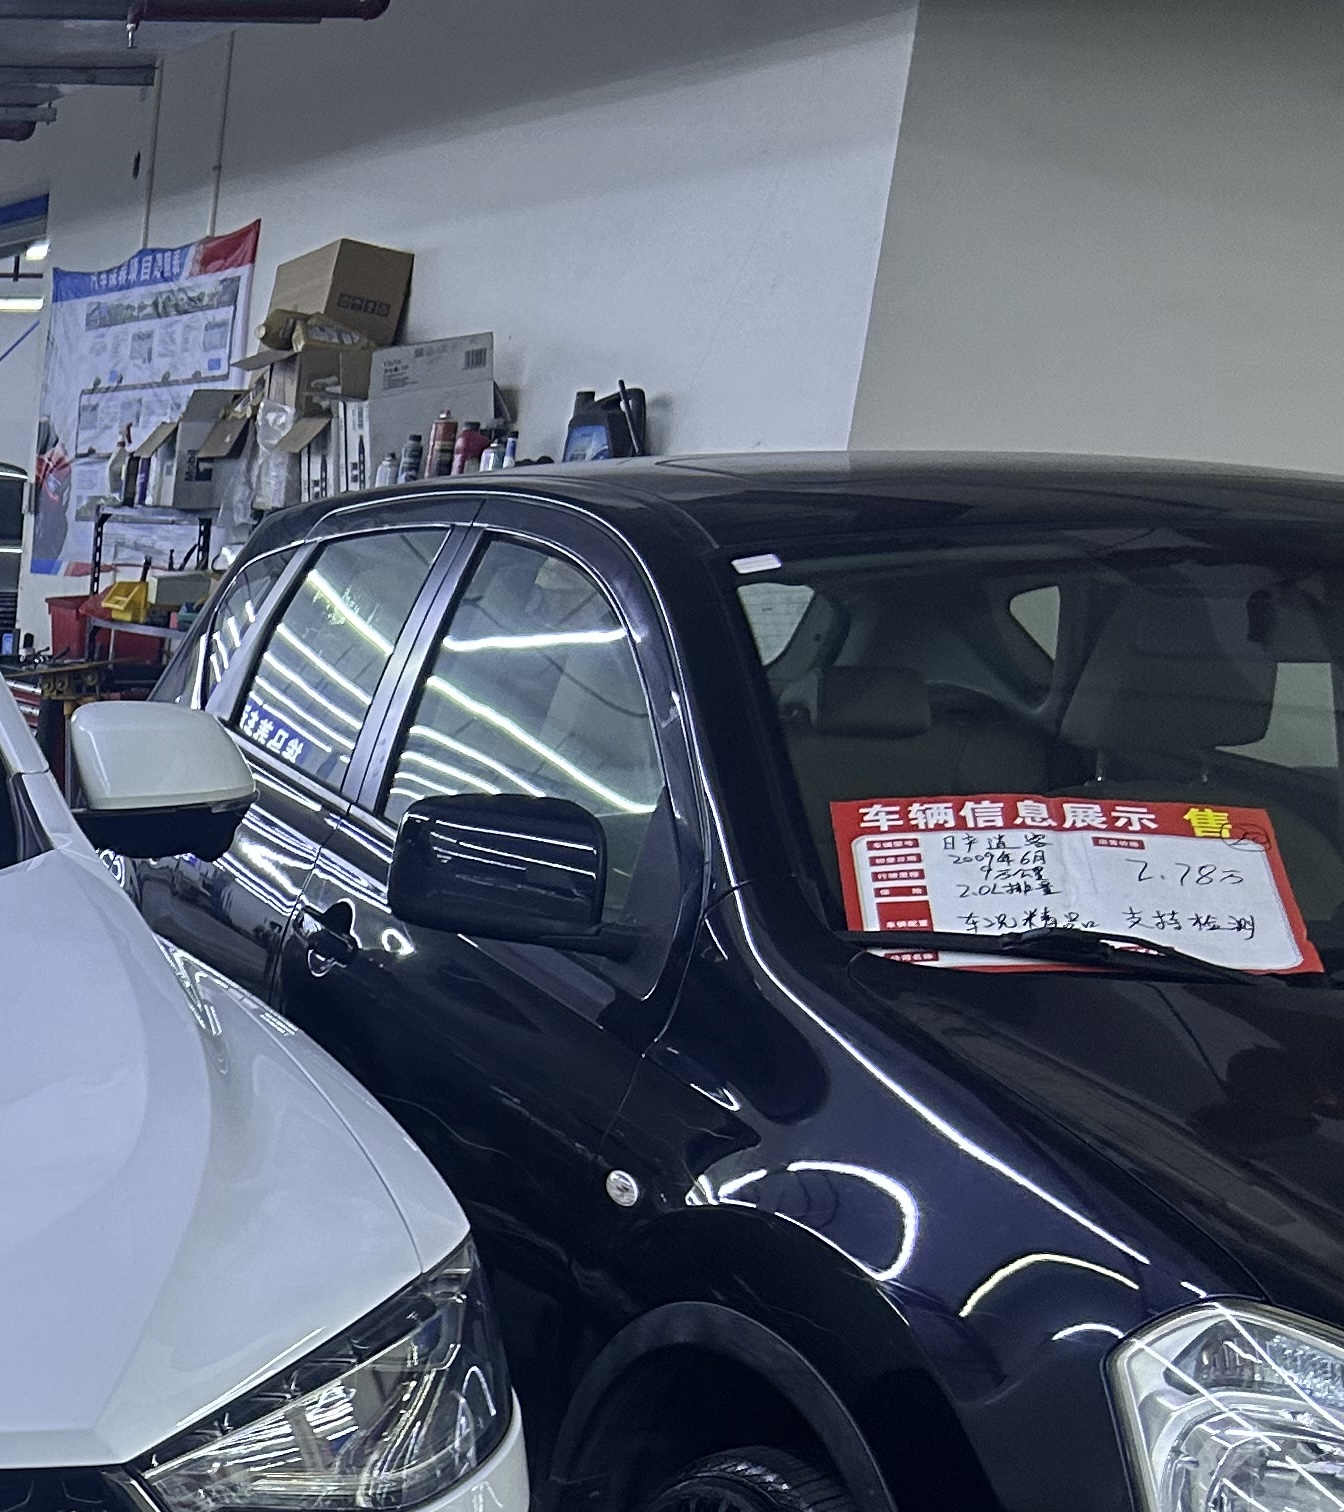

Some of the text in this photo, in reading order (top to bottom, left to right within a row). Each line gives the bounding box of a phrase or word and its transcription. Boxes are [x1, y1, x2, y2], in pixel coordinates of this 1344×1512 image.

[858, 799, 1160, 832] 车辆信息展示
[1183, 807, 1233, 838] 售
